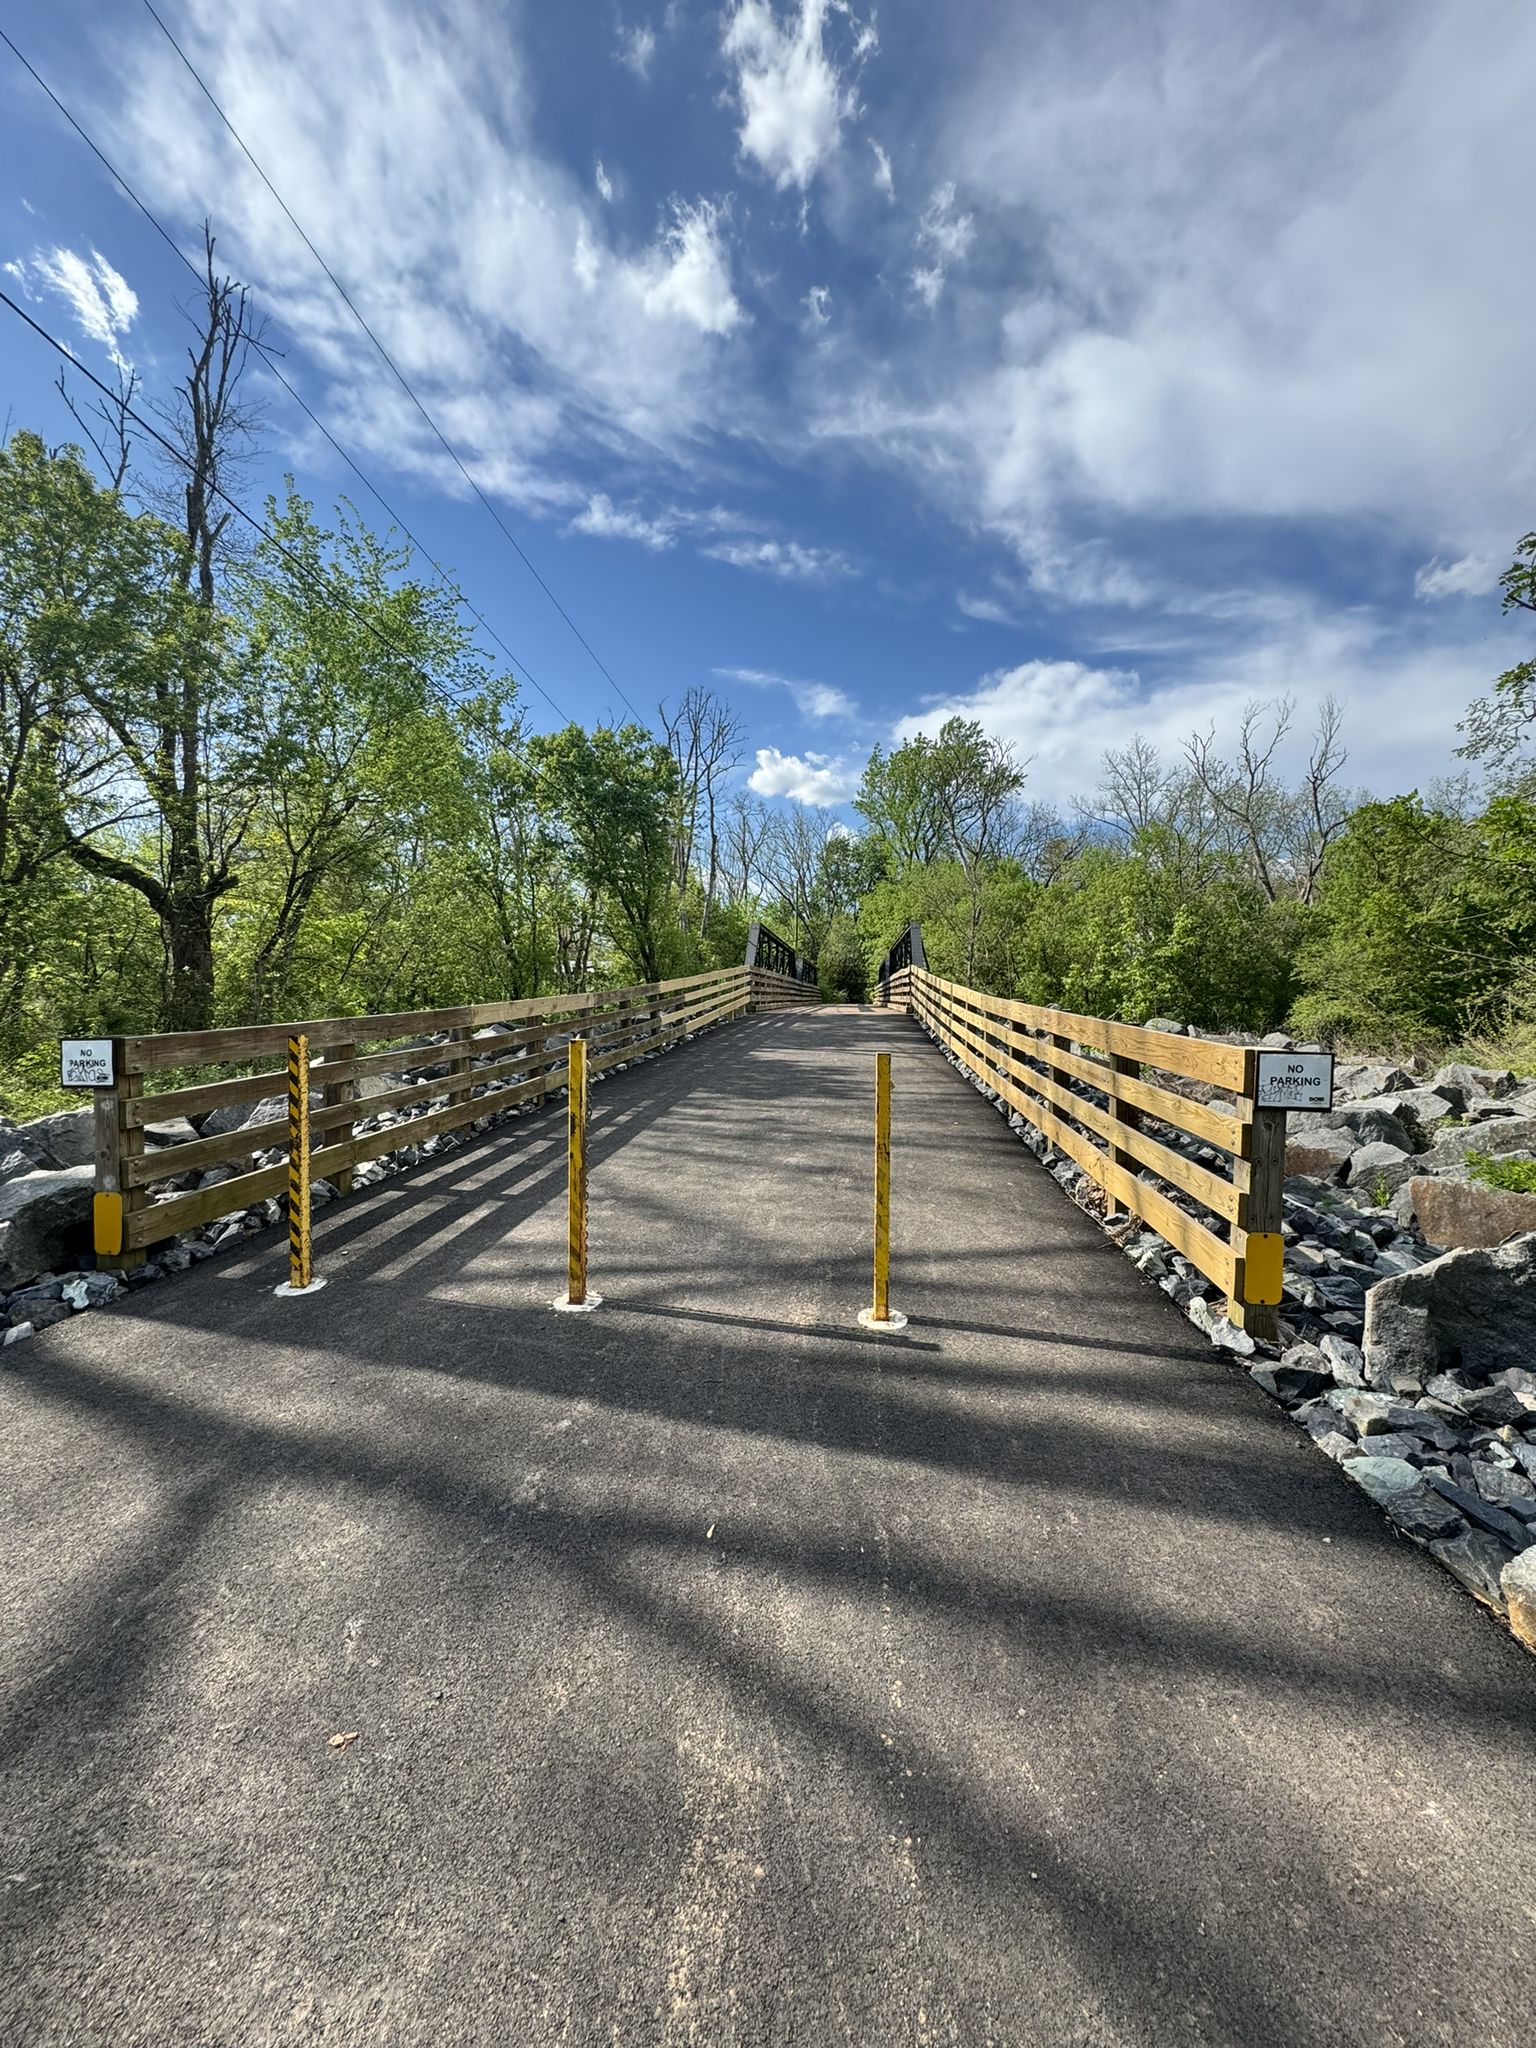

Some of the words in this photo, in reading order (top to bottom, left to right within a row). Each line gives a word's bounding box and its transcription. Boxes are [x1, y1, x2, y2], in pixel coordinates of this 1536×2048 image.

[80, 1049, 93, 1057] NO
[69, 1059, 106, 1067] PARKING
[1287, 1064, 1304, 1074] NO
[1270, 1076, 1321, 1087] PARKING
